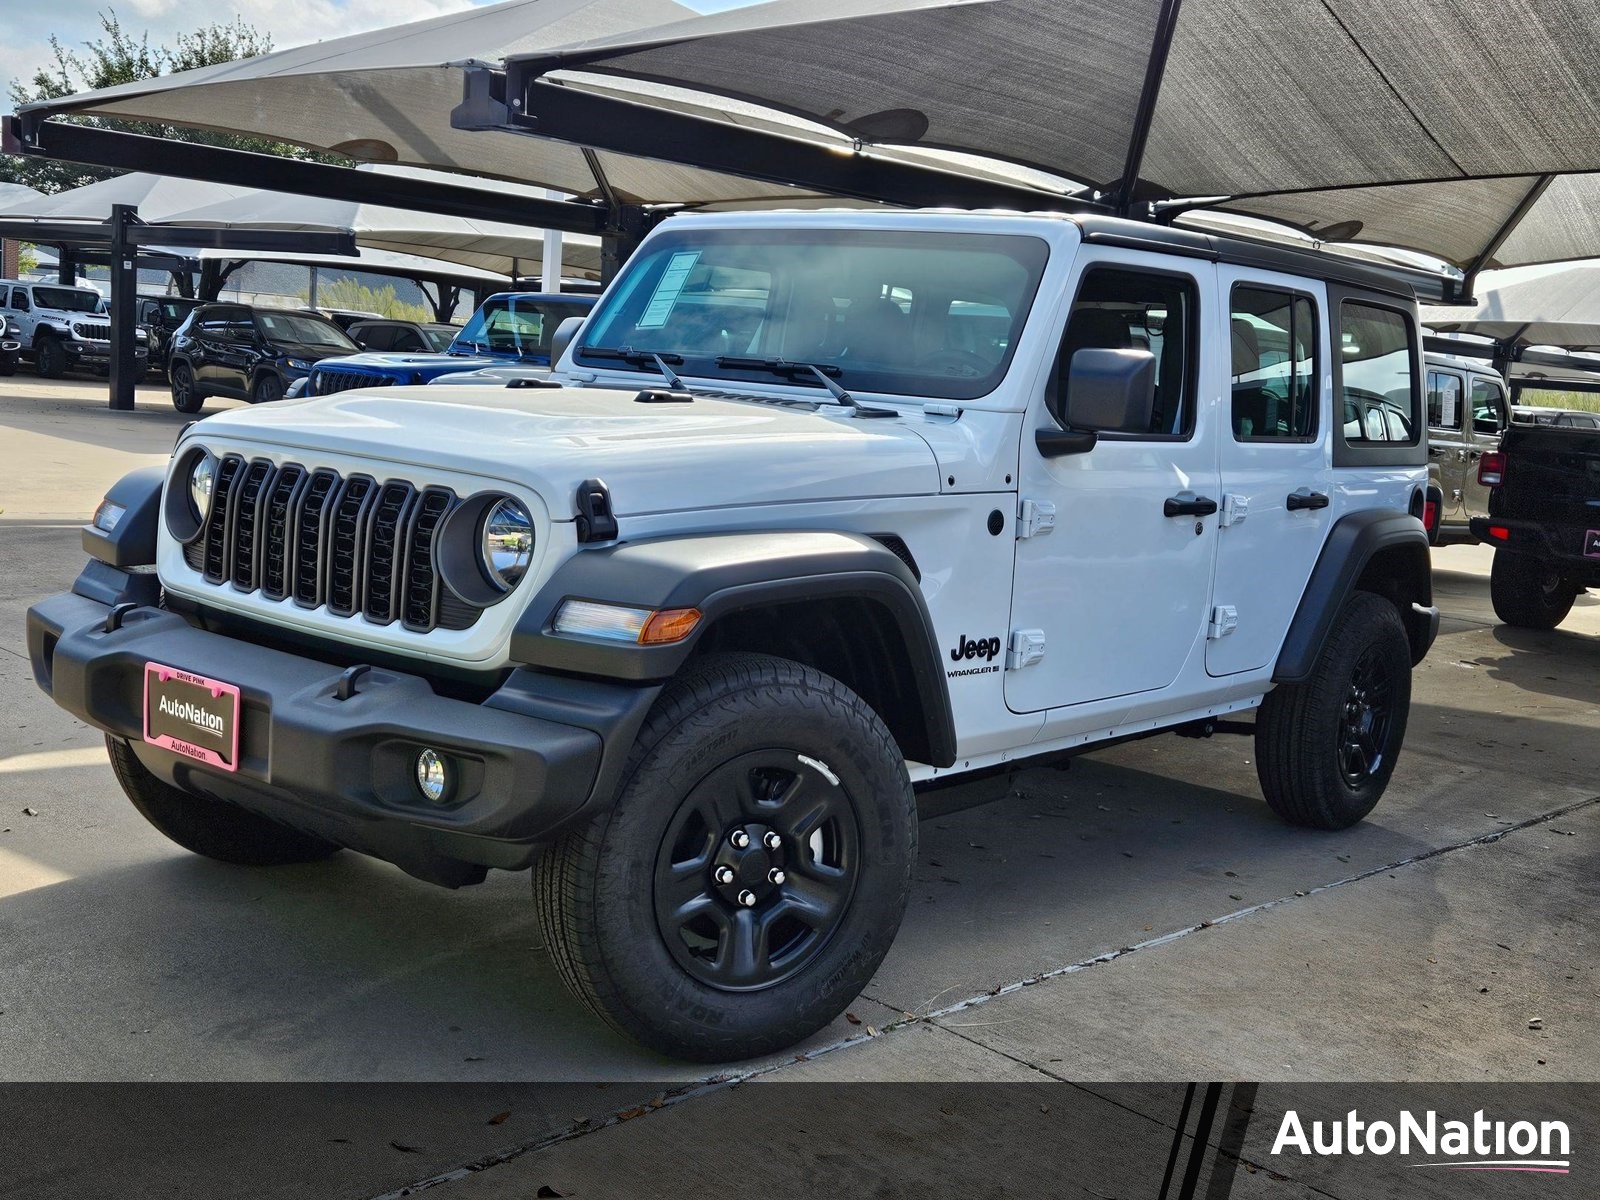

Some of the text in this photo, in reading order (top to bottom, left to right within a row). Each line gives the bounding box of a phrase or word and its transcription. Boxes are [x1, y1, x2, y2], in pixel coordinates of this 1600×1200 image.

[951, 634, 1000, 662] Jeep
[176, 671, 205, 686] DRIVE PINK
[947, 666, 992, 678] WRANGLER
[159, 695, 224, 731] AutoNation
[171, 740, 206, 760] AutoNation
